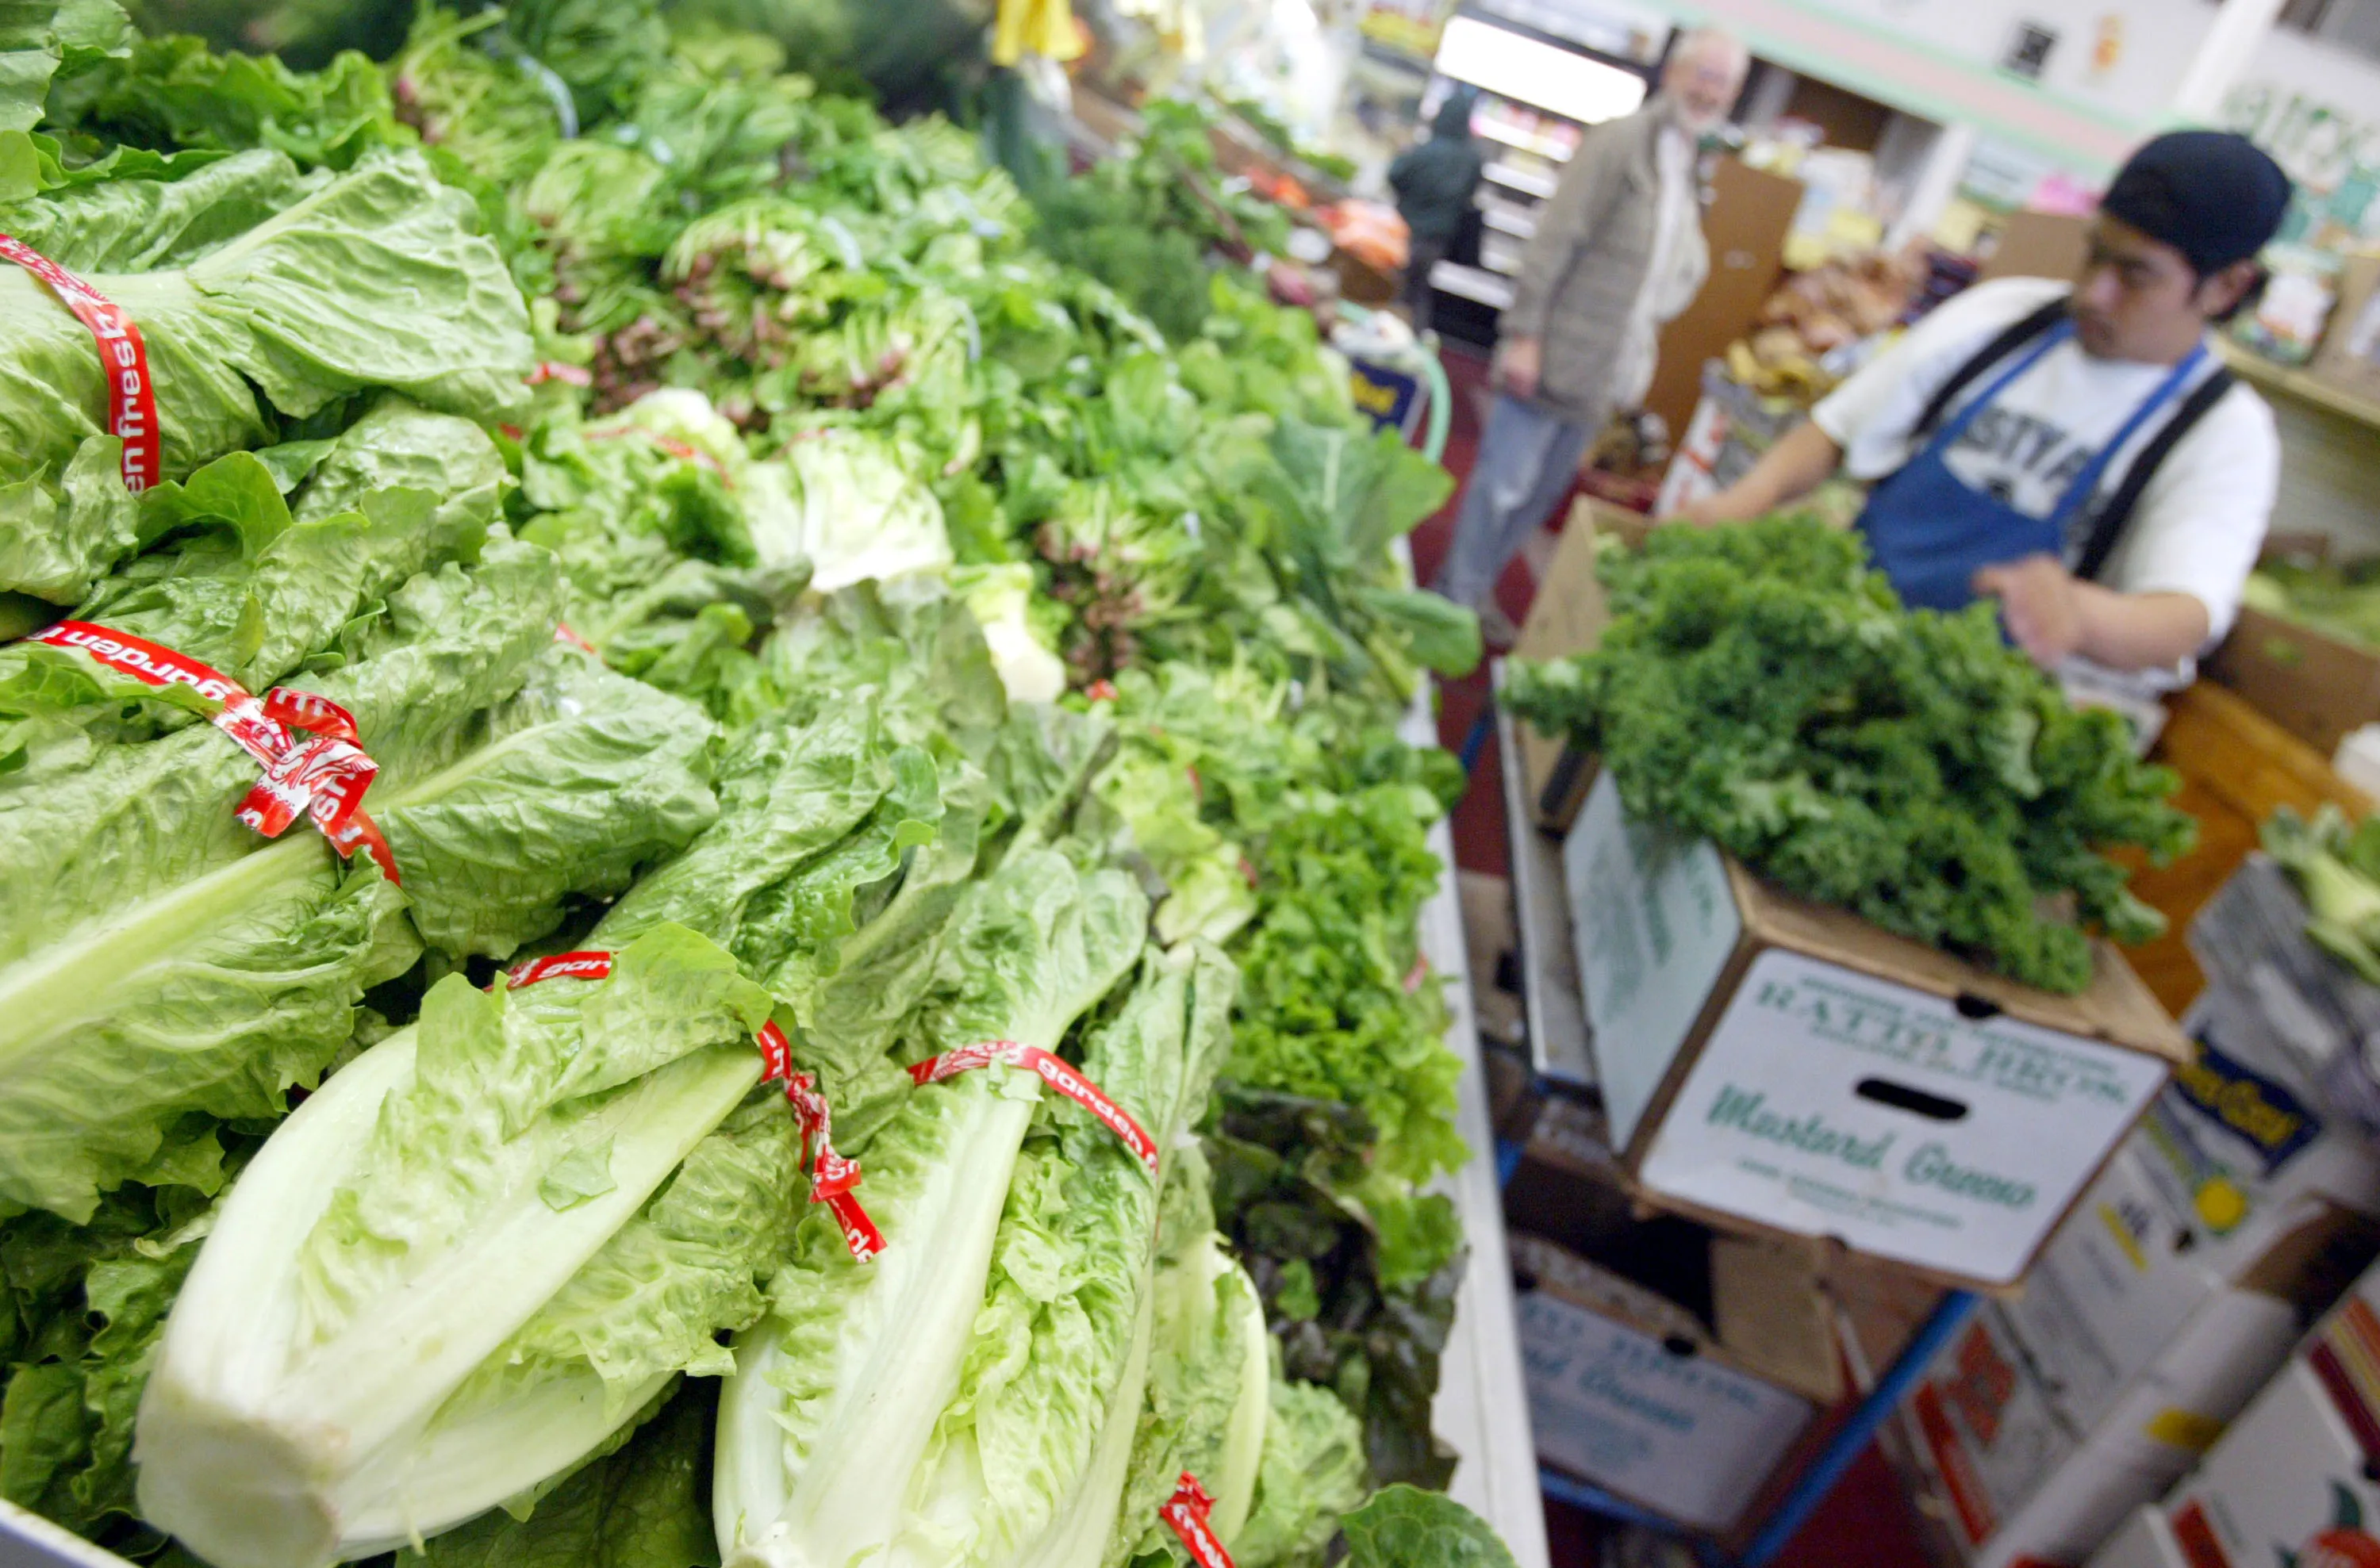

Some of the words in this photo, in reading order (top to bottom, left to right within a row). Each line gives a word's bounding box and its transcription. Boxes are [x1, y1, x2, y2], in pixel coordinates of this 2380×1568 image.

[63, 631, 232, 701] garden
[1037, 1057, 1144, 1154] garden
[1704, 1083, 1898, 1171] Mustard
[1904, 1140, 2039, 1212] Greens
